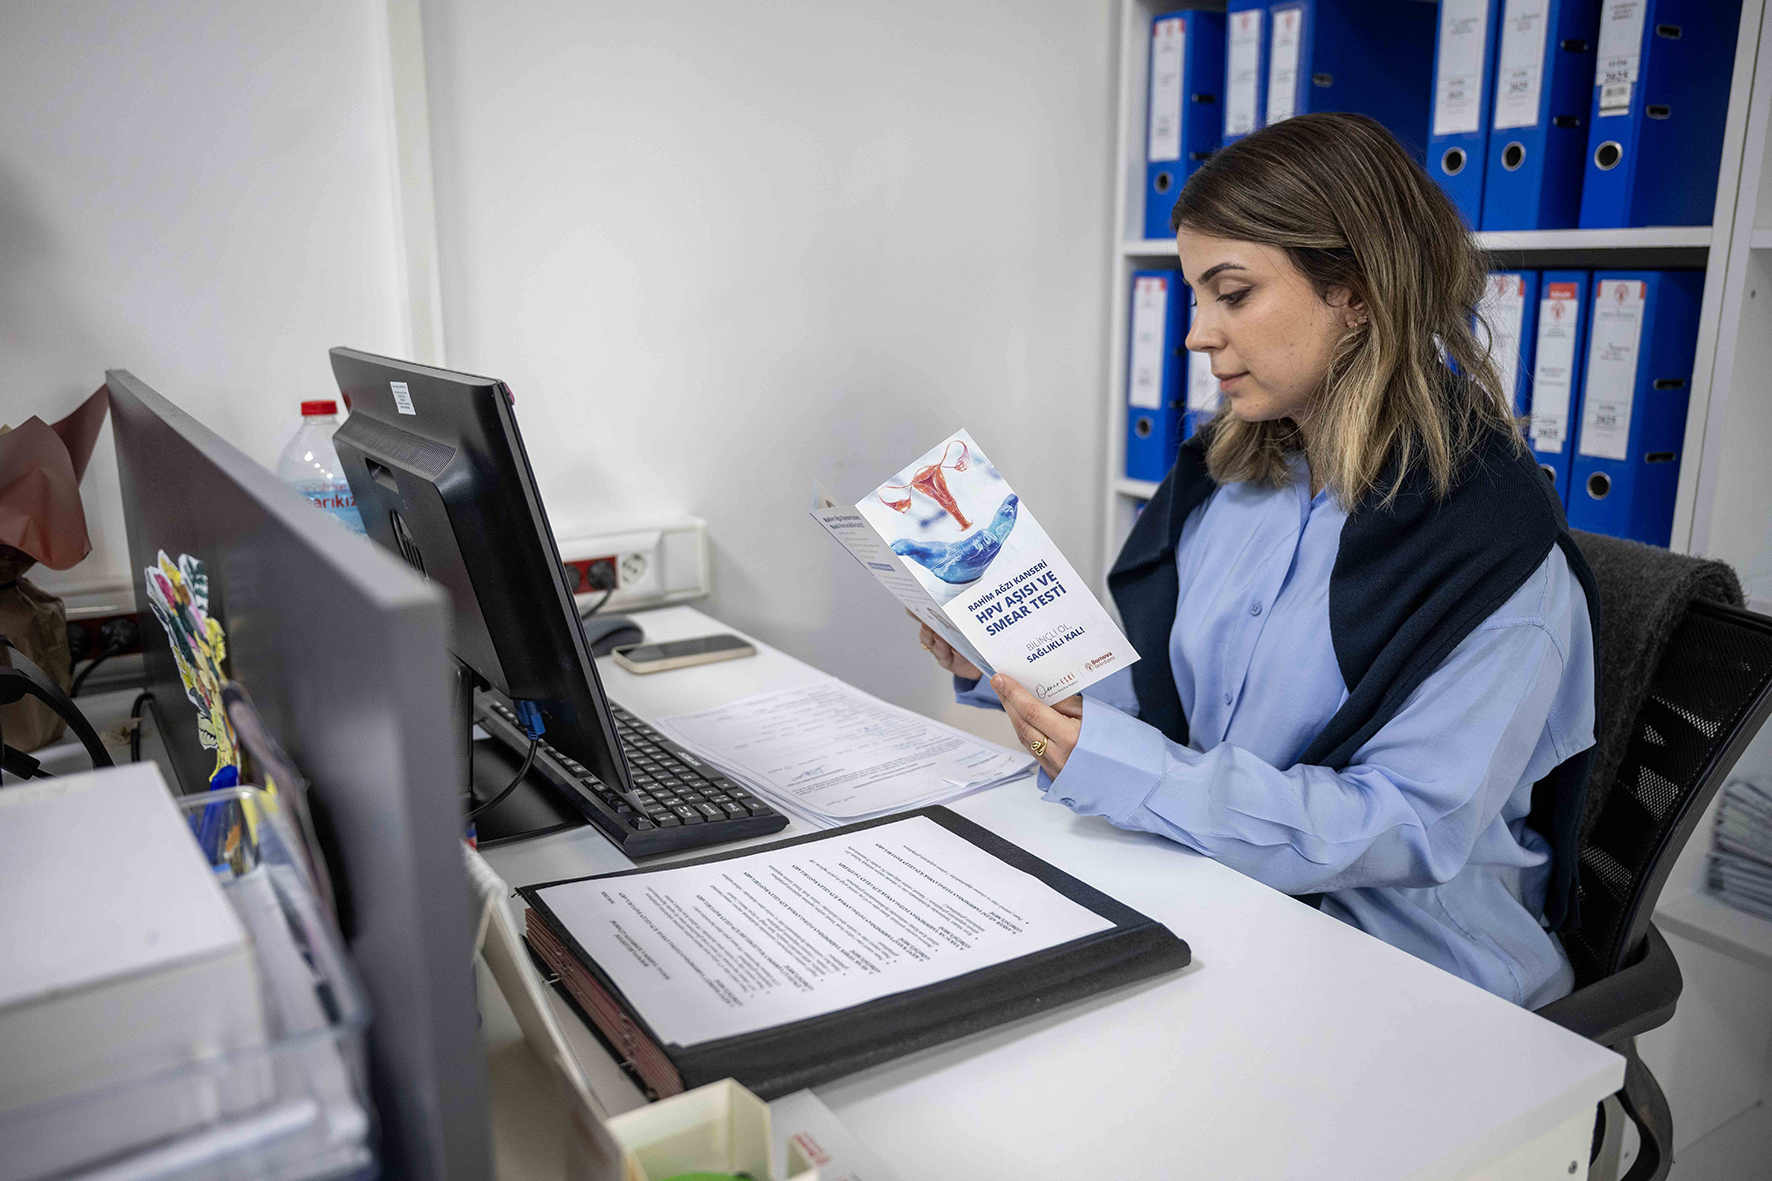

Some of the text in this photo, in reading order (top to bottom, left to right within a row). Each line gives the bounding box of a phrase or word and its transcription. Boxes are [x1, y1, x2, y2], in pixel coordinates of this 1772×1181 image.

[968, 559, 1048, 612] RAHİM AĞZI KANSERİ
[976, 570, 1057, 624] HPV AŞISI VE
[986, 582, 1067, 636] SMEAR TESTİ
[1026, 626, 1085, 663] SAĞLIKLI KAL!
[1091, 651, 1113, 665] Bornova
